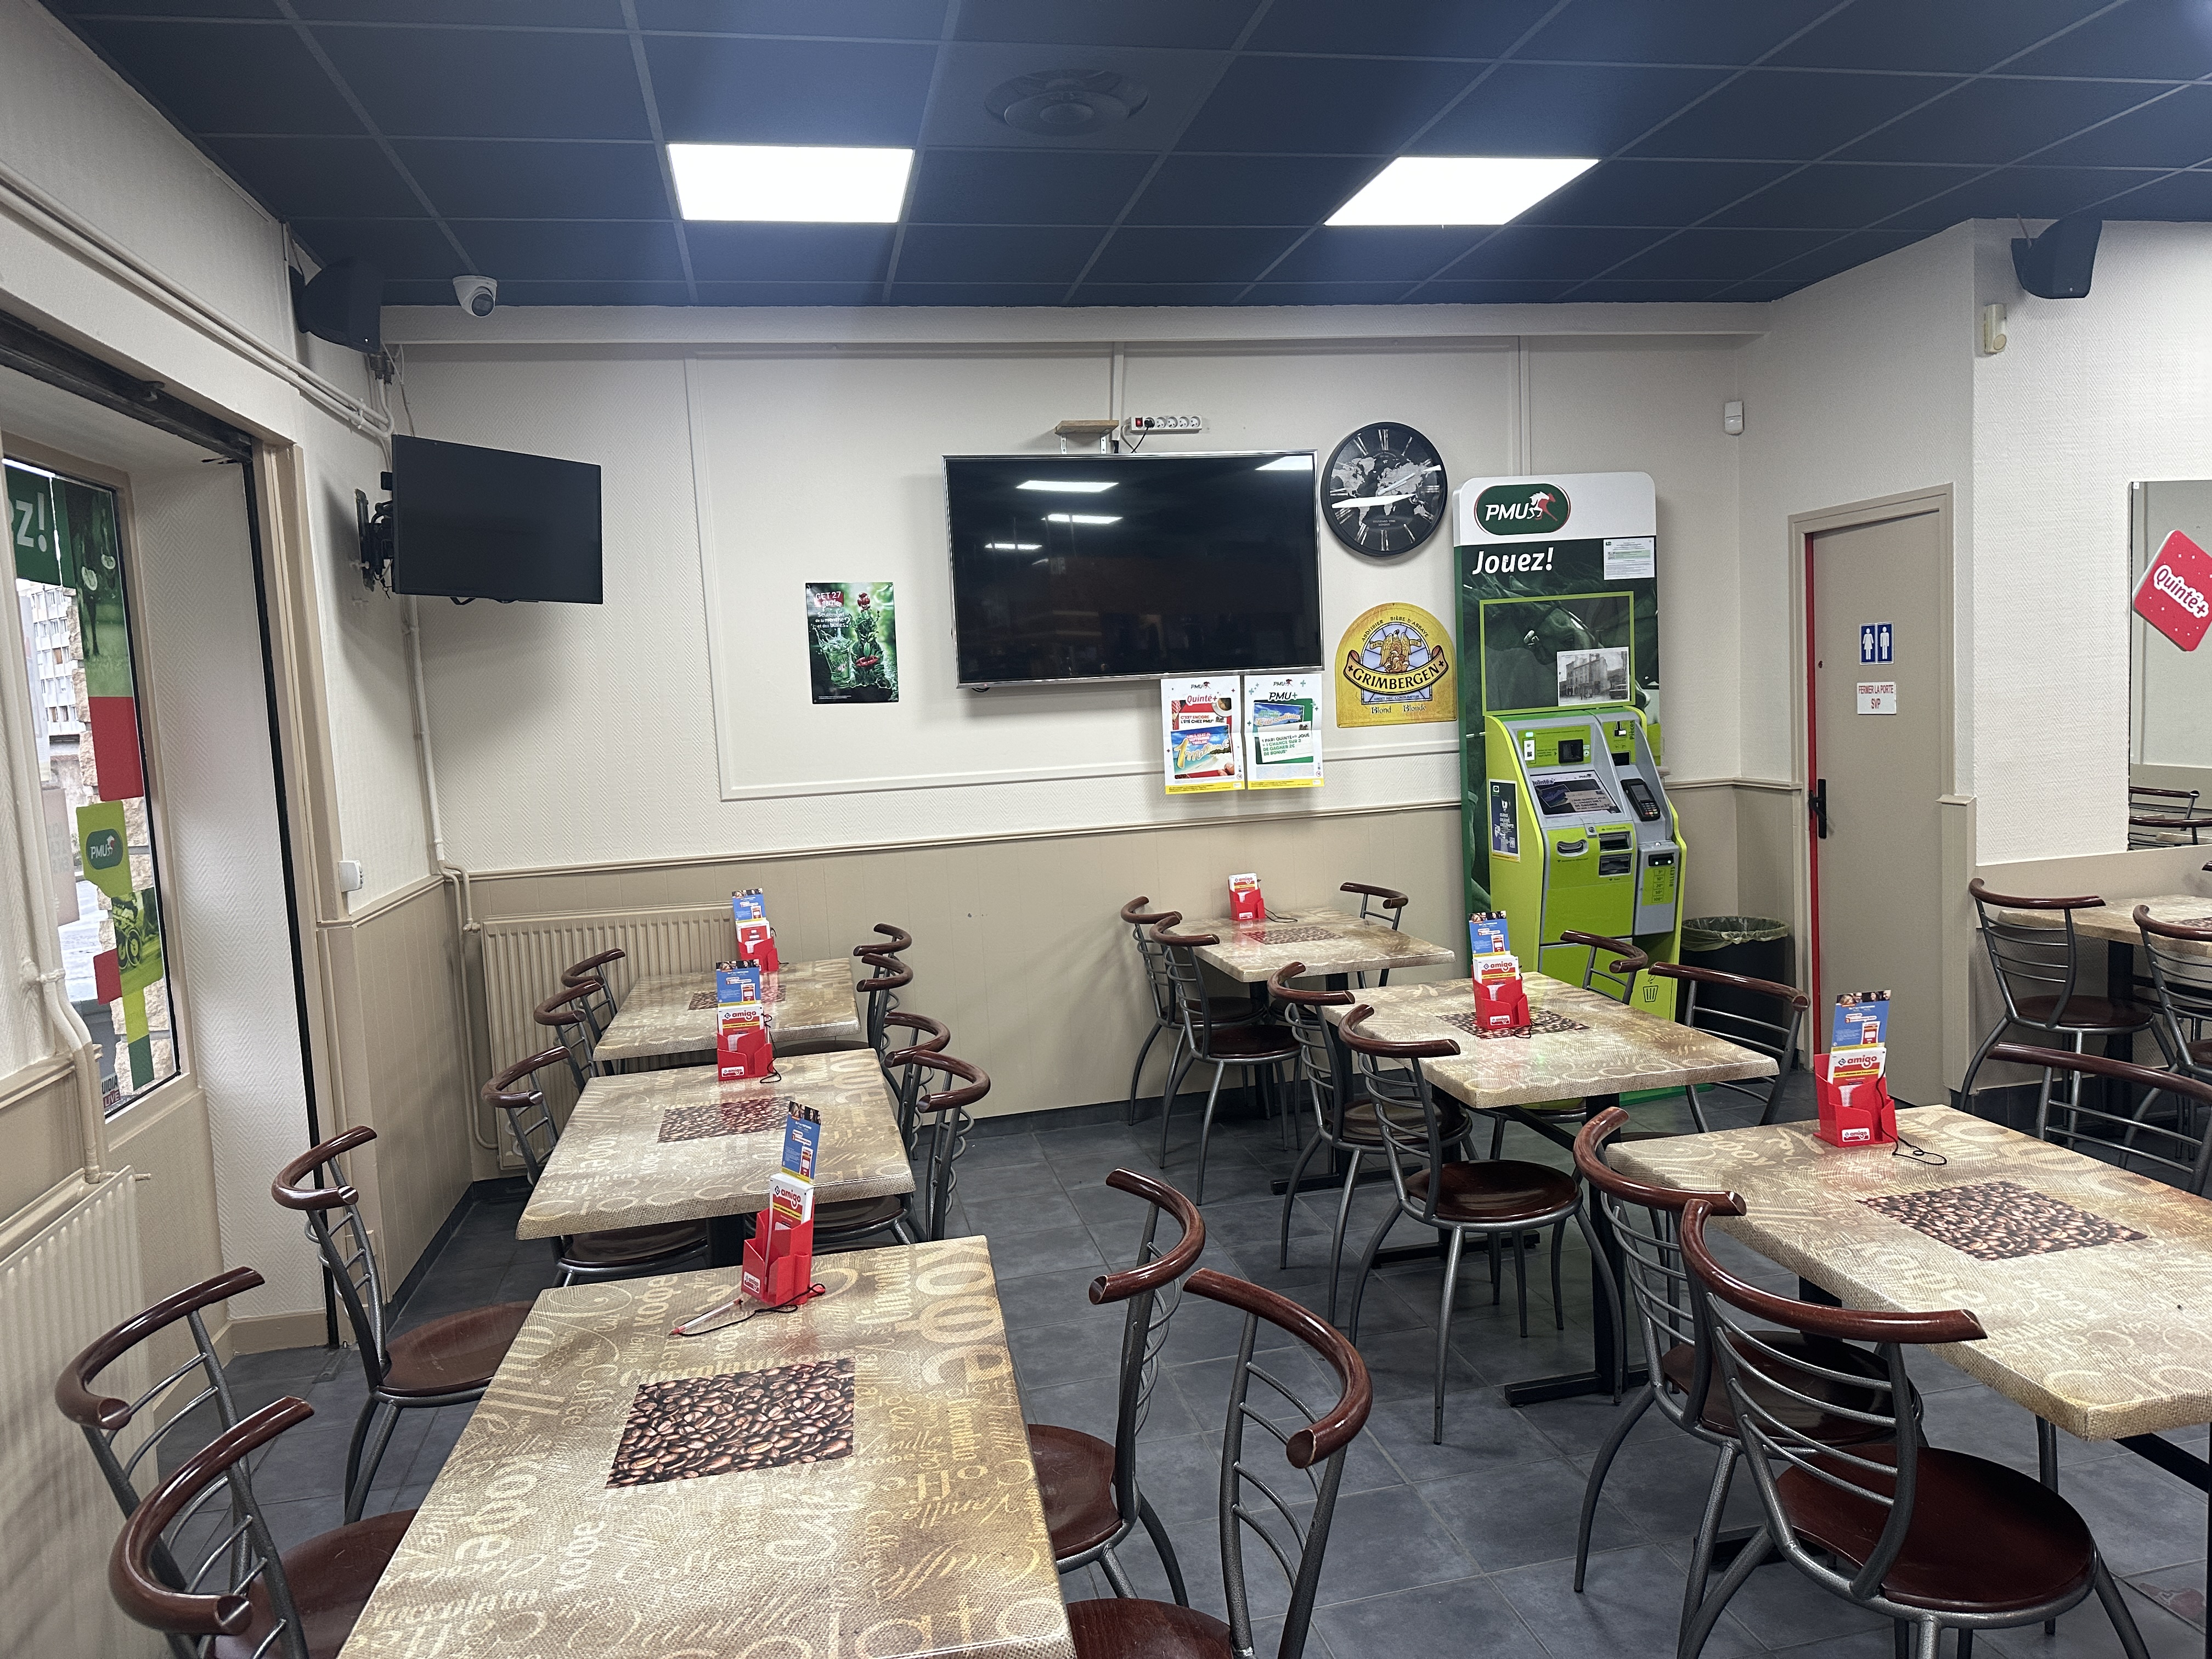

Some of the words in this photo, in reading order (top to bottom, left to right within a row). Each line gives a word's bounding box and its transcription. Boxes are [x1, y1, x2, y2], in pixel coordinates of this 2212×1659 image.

[1485, 503, 1530, 521] PMU
[1472, 547, 1554, 575] Jouez!
[815, 592, 831, 600] GET
[831, 591, 842, 599] 27
[2157, 568, 2206, 614] Quinté+
[1352, 663, 1440, 690] GRIMBERGEN
[1187, 695, 1218, 704] Quinté+
[1858, 685, 1874, 694] FERMER
[1875, 685, 1880, 694] LA
[1880, 685, 1894, 694] PORTE
[1371, 706, 1391, 714] Blond
[1871, 698, 1881, 709] SVP
[1173, 738, 1189, 769] 1
[91, 845, 108, 860] PMU
[1490, 960, 1513, 971] amigo
[732, 1009, 757, 1020] amigo
[1847, 1054, 1877, 1067] amigo
[649, 1069, 681, 1090] кофе
[823, 1050, 887, 1104] кофе
[104, 1090, 120, 1107] LIVE
[1849, 1130, 1867, 1138] amigo
[572, 1132, 625, 1169] кофе
[1699, 1133, 1777, 1167] кофе
[1896, 1107, 2172, 1197] кофе
[638, 1151, 667, 1174] кофе
[781, 1188, 802, 1207] amigo
[1865, 1240, 1987, 1305] кофе
[632, 1275, 681, 1329] кофе
[894, 1241, 1014, 1386] кофе
[455, 1452, 551, 1562] кофе
[551, 1520, 606, 1592] кофе
